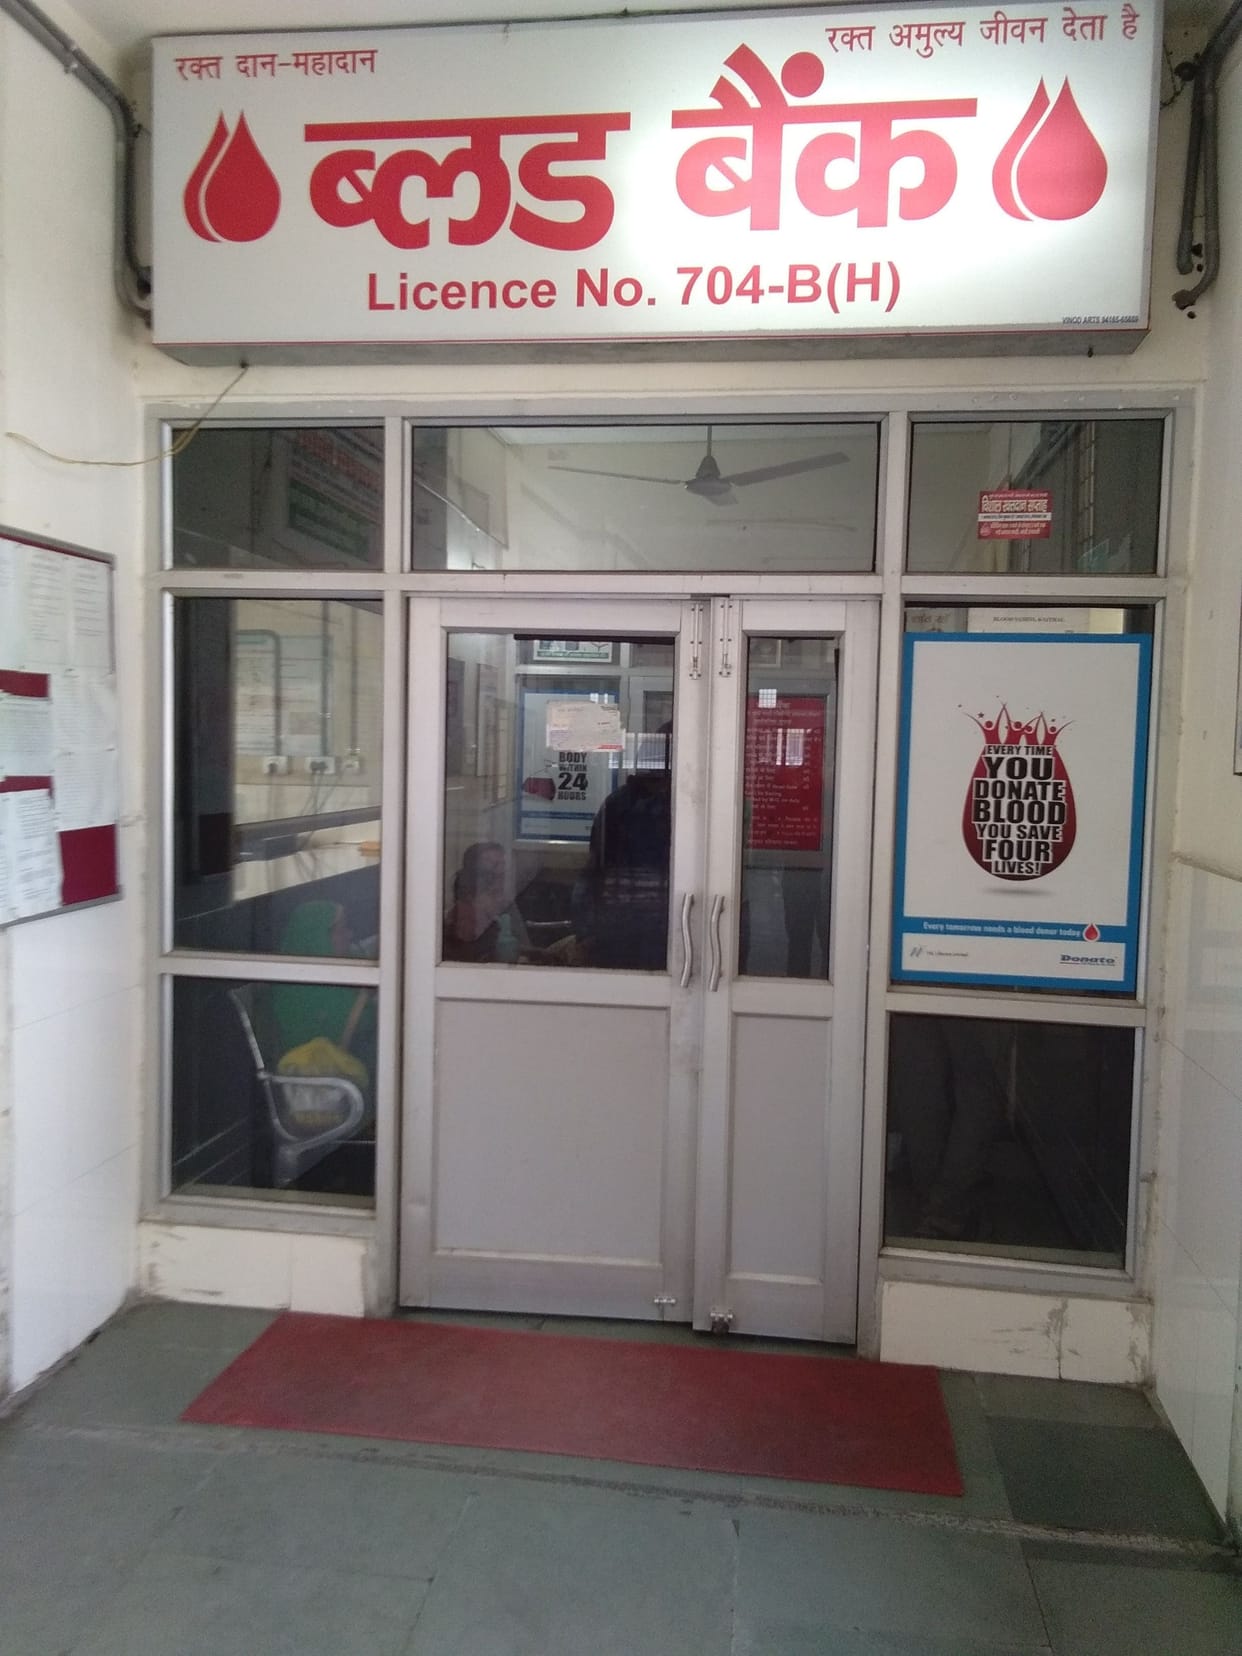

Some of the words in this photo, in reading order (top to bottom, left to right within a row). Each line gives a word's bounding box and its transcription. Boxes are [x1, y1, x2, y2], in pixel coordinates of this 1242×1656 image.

[824, 25, 876, 52] रक्त
[888, 21, 966, 58] अमुल्य
[979, 10, 1048, 45] जीवन
[1061, 6, 1107, 41] देता
[1120, 3, 1140, 40] है
[174, 56, 222, 81] रक्त
[304, 112, 631, 251] ब्लड
[672, 42, 978, 231] बैंक
[367, 273, 557, 311] Licence
[576, 268, 656, 308] No.
[676, 261, 901, 314] 704-B(H)
[559, 752, 587, 763] BODY
[987, 745, 1022, 755] EVERY
[1024, 745, 1053, 756] TIME
[984, 756, 1053, 781] YOU
[558, 772, 588, 791] 24
[974, 779, 1065, 801] DONATE
[973, 799, 1066, 825] BLOOD
[976, 823, 1012, 839] YOU
[1015, 825, 1062, 841] SAVE
[984, 839, 1051, 862] FOUR
[994, 861, 1040, 875] LIVES!
